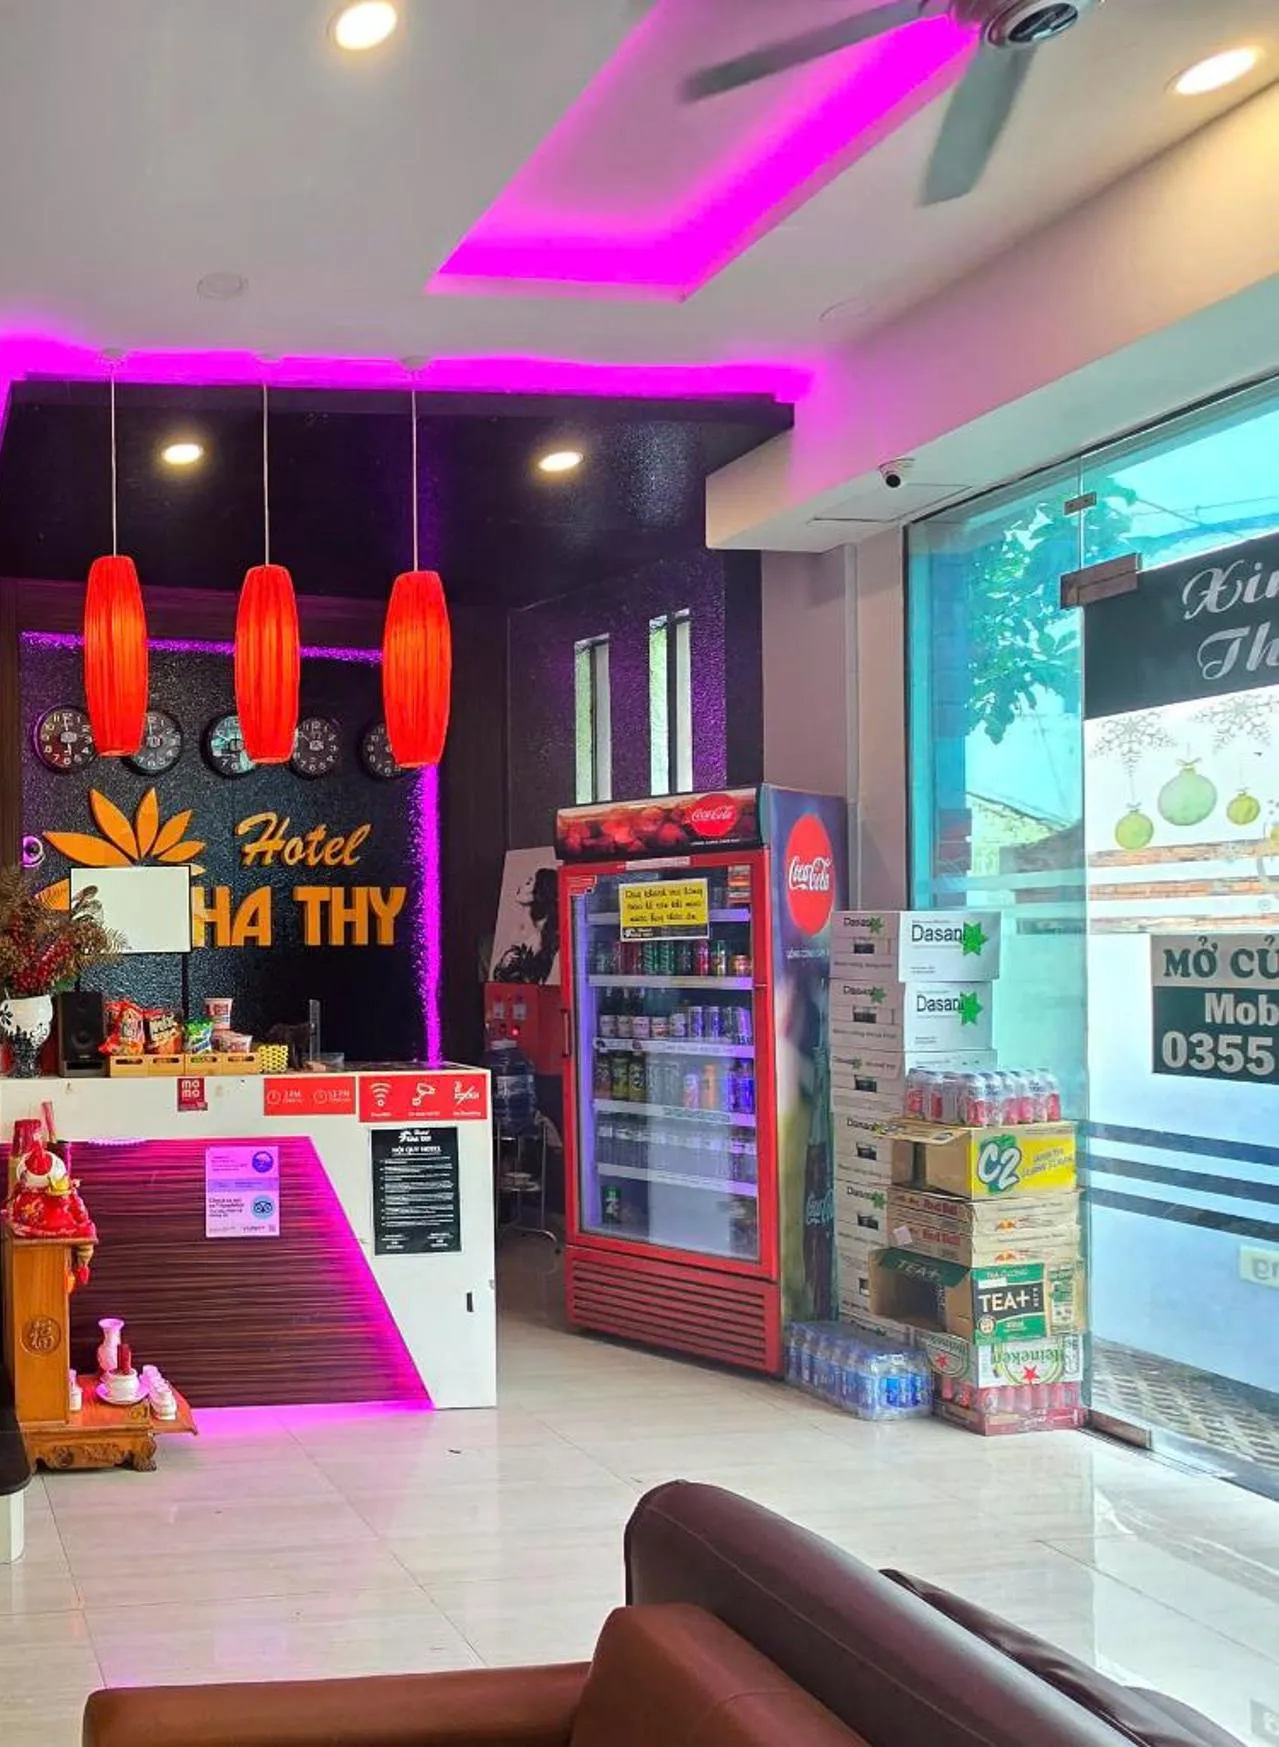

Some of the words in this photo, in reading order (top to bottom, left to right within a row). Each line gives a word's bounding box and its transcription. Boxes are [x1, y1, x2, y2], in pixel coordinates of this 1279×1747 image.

[691, 805, 734, 821] Coca-Cola
[235, 811, 372, 867] Hotel
[191, 885, 272, 947] HA
[294, 886, 407, 946] THY
[1163, 936, 1218, 978] MỞ
[1162, 1031, 1275, 1076] 0355
[978, 1141, 1021, 1191] C2
[978, 1289, 1031, 1313] TEA+
